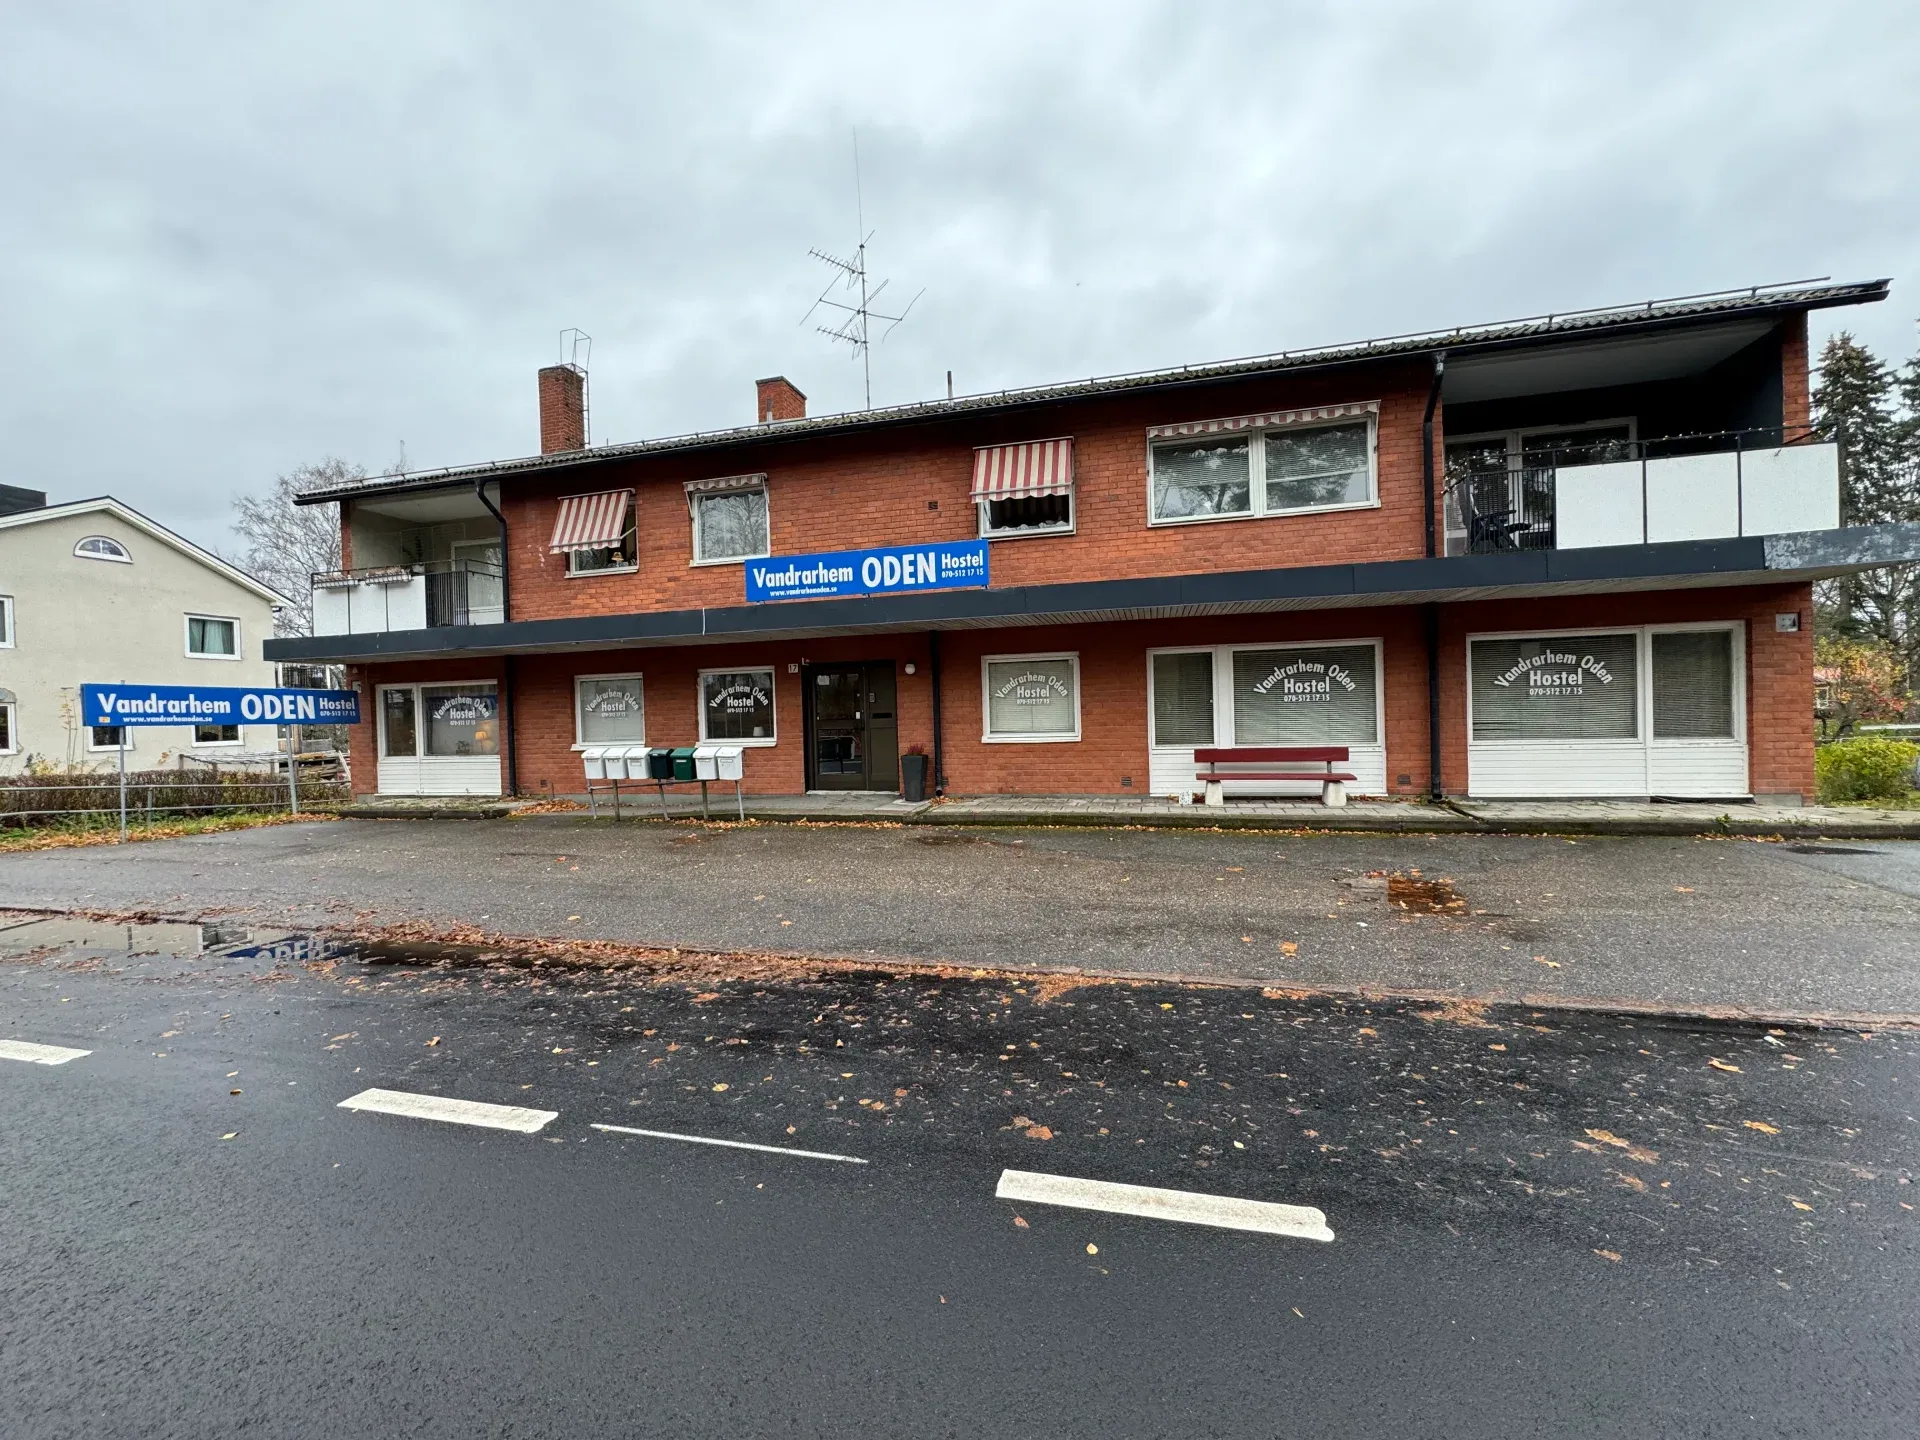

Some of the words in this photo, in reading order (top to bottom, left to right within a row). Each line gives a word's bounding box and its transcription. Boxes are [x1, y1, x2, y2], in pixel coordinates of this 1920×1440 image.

[753, 561, 853, 588] Vandrarhem
[861, 552, 936, 588] ODEN
[941, 549, 984, 569] Hostel
[941, 569, 966, 578] 070-512
[967, 568, 975, 577] 17
[976, 567, 984, 576] 15
[788, 664, 798, 672] 17
[1253, 658, 1325, 694] Vandrarhem
[1328, 664, 1356, 692] Oden
[1494, 649, 1577, 687] Vandrarhem
[1581, 655, 1613, 684] Oden
[1529, 667, 1583, 686] Hostel
[995, 671, 1046, 698] Vandrarhem
[1048, 675, 1068, 697] Oden
[1016, 684, 1050, 698] Hostel
[1283, 676, 1330, 693] Hostel
[1529, 688, 1560, 696] 070-512
[1562, 687, 1571, 695] 17
[1573, 687, 1583, 695] 15
[585, 688, 623, 712] Vandrarhem
[624, 692, 639, 710] Oden
[709, 682, 751, 708] Vandrarhem
[752, 687, 769, 706] Oden
[727, 694, 754, 707] Hostel
[1283, 694, 1310, 702] 070-512
[1322, 693, 1330, 701] 15
[97, 692, 231, 714] Vandrarhem
[240, 693, 316, 720] ODEN
[319, 697, 356, 710] Hostel
[433, 693, 472, 719] Vandrarhem
[474, 698, 490, 718] Oden
[450, 707, 476, 719] Hostel
[601, 700, 626, 712] Hostel
